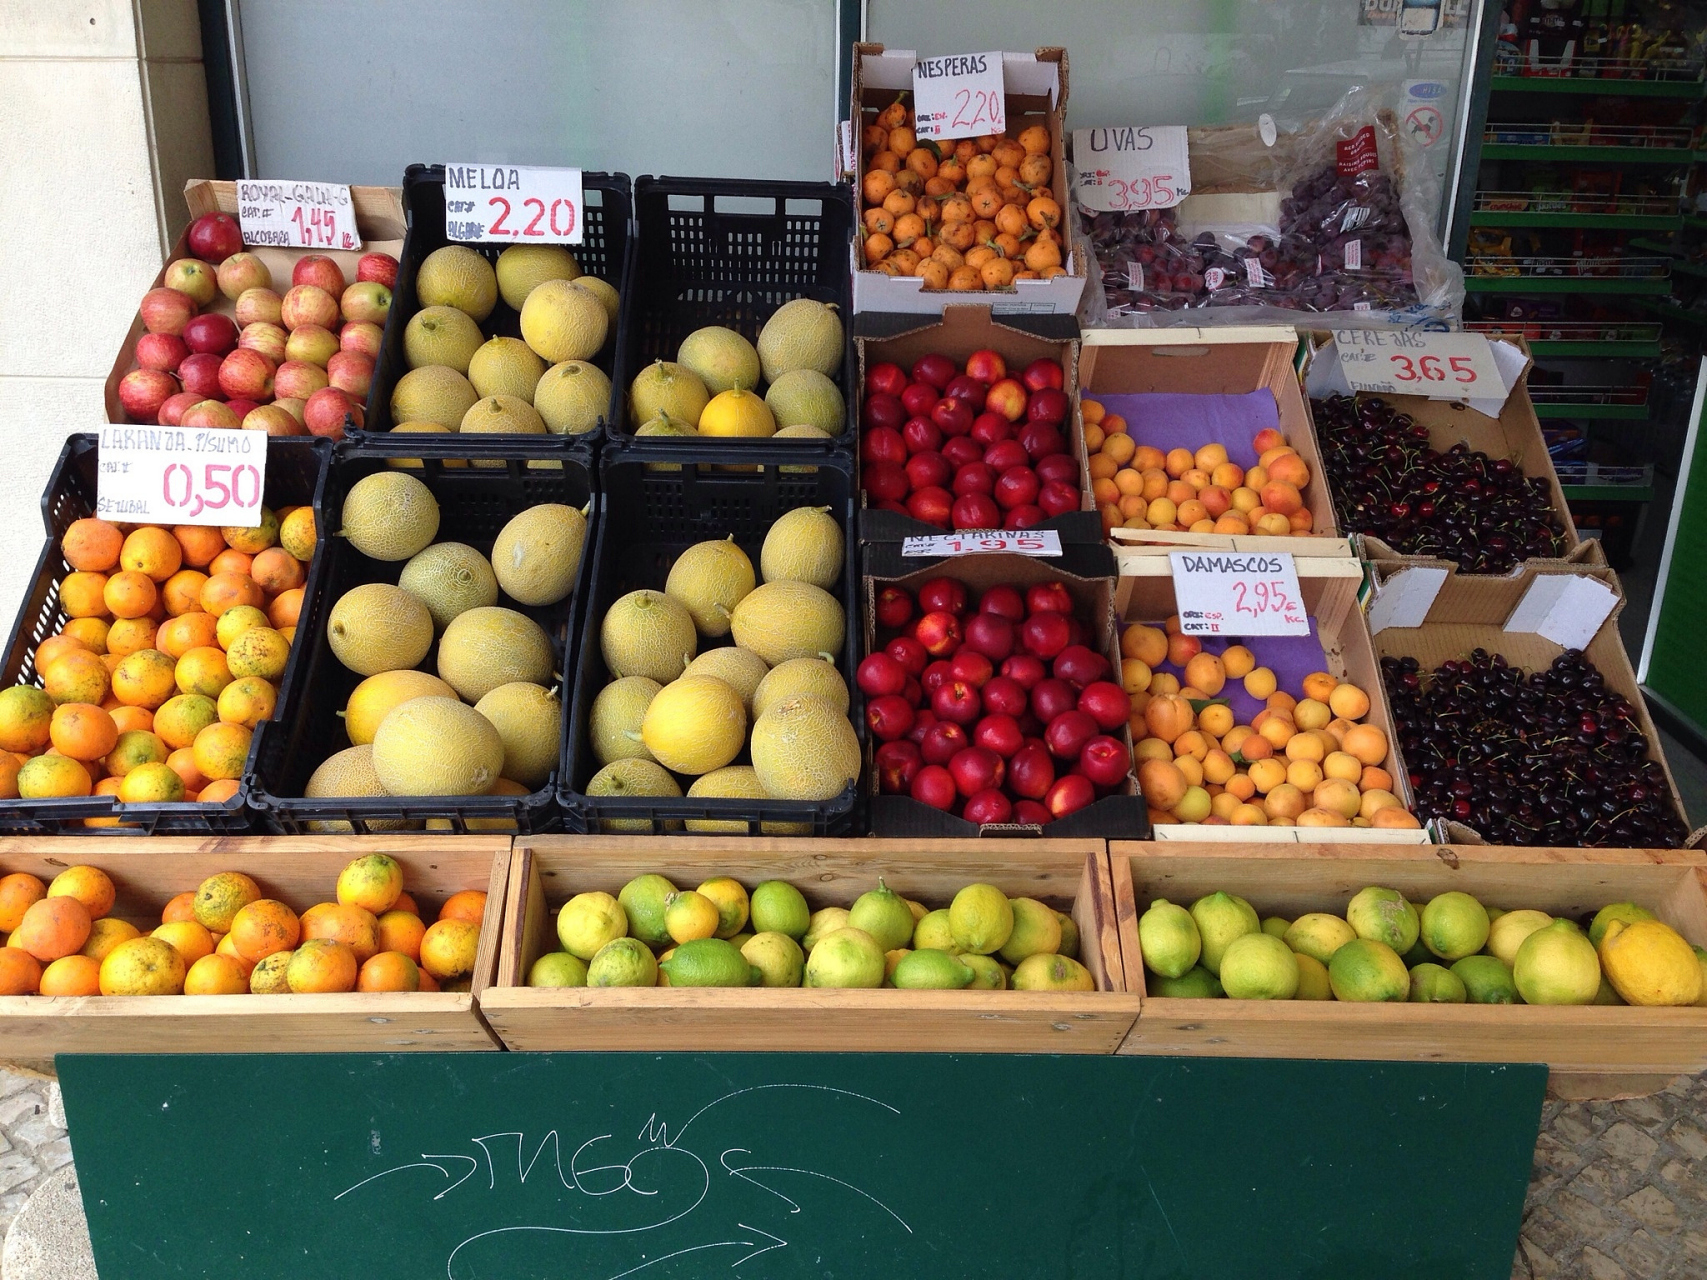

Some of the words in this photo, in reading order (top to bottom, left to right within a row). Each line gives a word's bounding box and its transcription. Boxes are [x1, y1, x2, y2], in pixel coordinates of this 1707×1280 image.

[917, 54, 987, 79] NESPERAS
[1090, 127, 1153, 152] UVAS
[448, 167, 520, 190] MELOA
[1108, 175, 1174, 211] 3,95
[291, 206, 336, 246] 1,45
[488, 197, 575, 238] 2,20
[1337, 331, 1426, 348] CEREJAS
[1390, 355, 1477, 383] 3,65
[163, 463, 260, 517] 0,50
[1182, 556, 1282, 573] DAMASCOS
[1232, 581, 1287, 618] 2,95
[1183, 623, 1209, 631] CAT:
